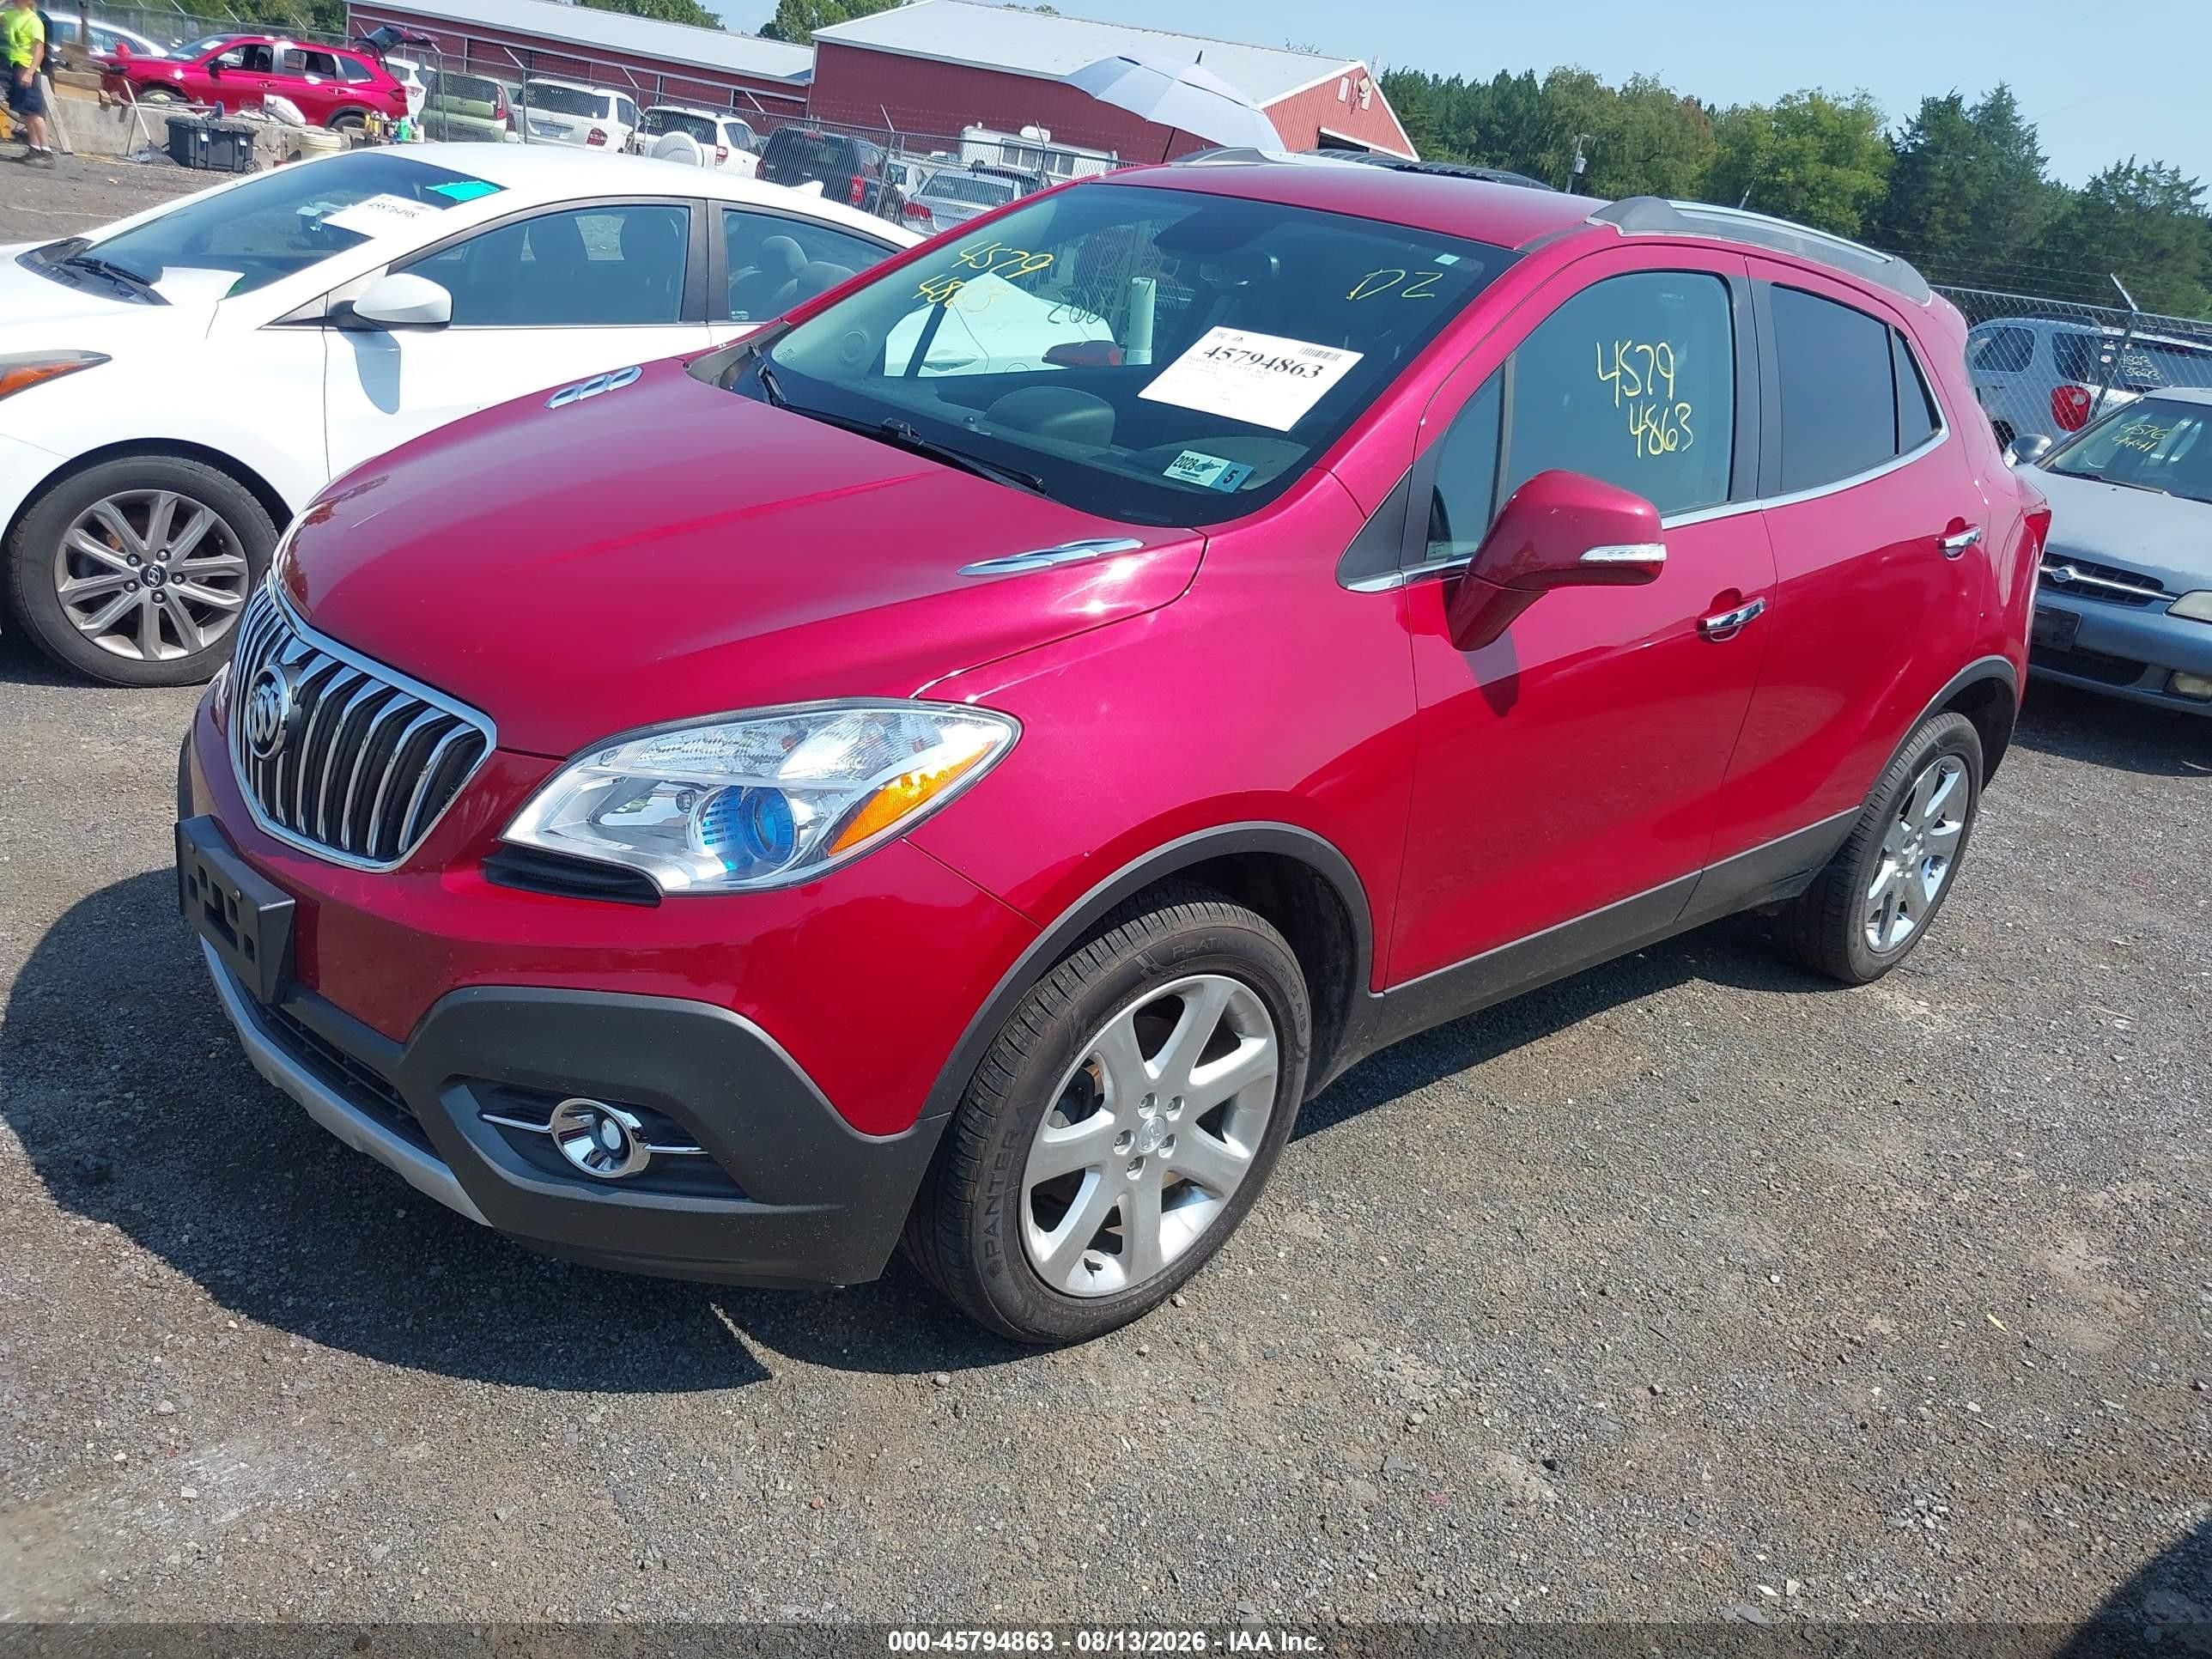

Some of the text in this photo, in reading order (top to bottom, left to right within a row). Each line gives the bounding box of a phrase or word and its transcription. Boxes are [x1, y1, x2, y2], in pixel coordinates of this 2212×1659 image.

[951, 241, 1054, 279] 4579
[1203, 345, 1324, 379] 45794863
[1595, 340, 1674, 410] 4579
[1629, 400, 1694, 459] 4863
[1172, 455, 1200, 471] 2028
[1223, 469, 1240, 484] 5
